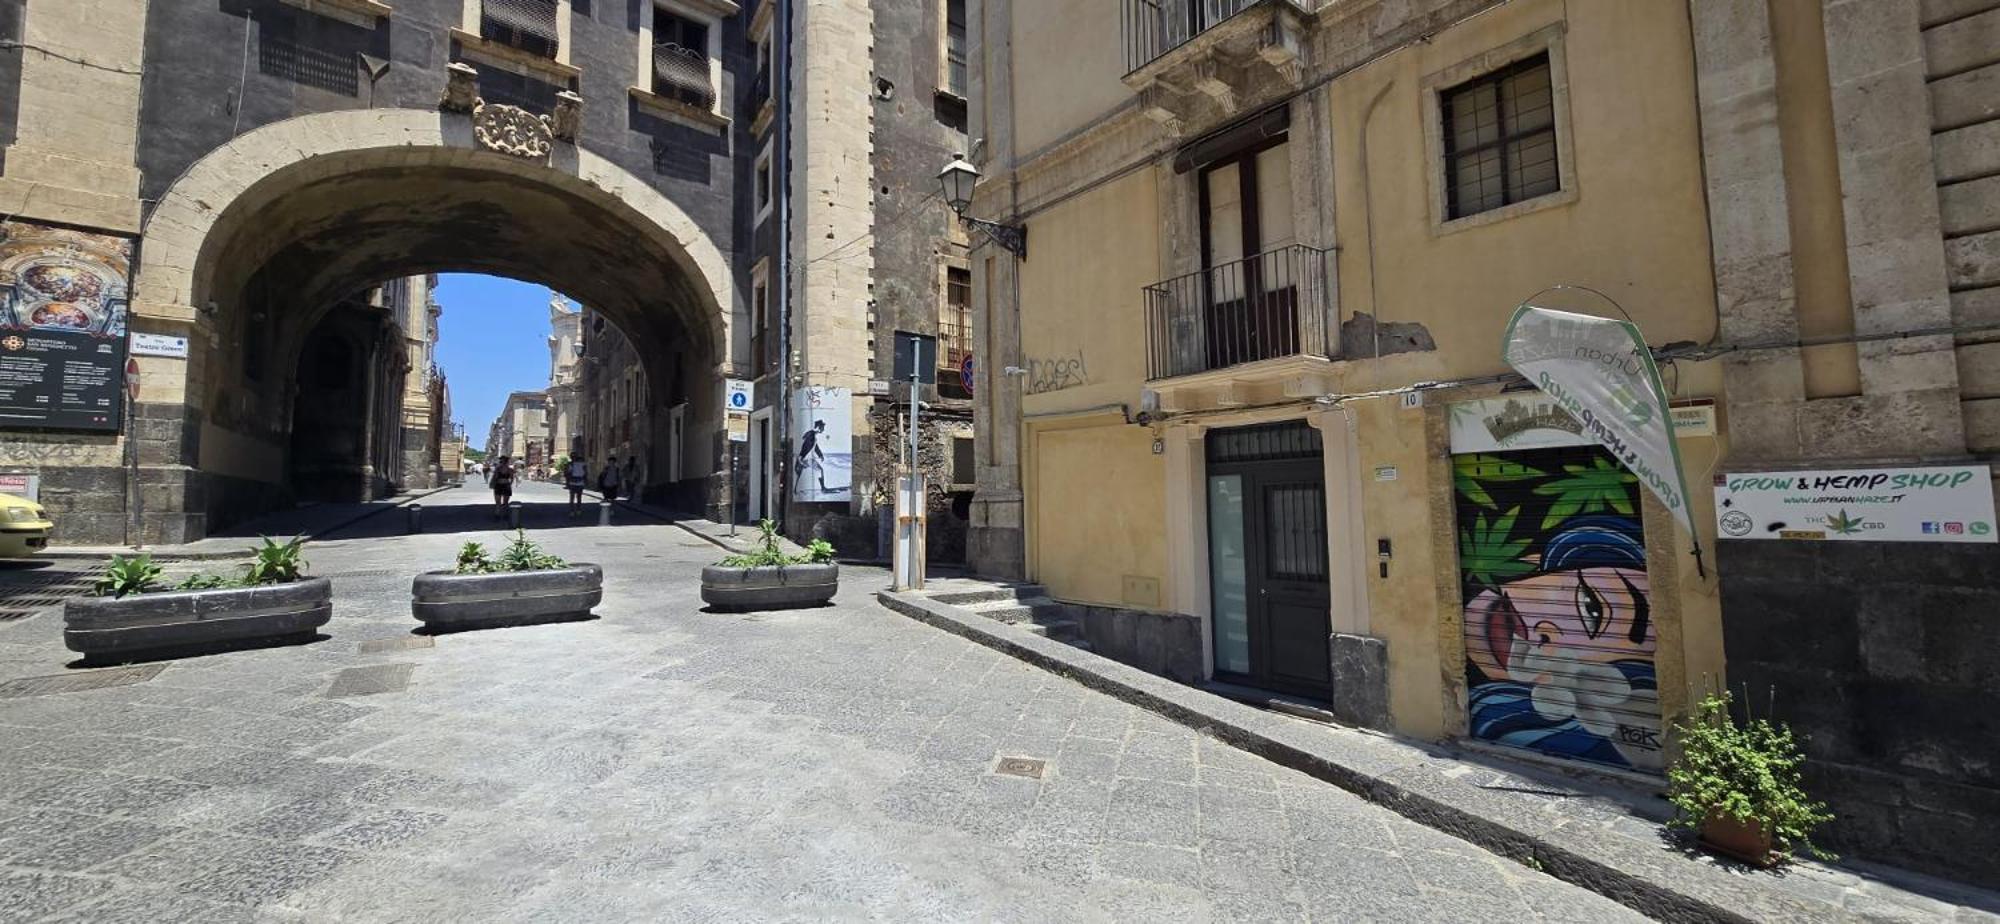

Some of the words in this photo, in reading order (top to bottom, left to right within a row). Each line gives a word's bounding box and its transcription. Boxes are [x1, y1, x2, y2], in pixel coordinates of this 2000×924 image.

[1406, 394, 1417, 406] 10
[1729, 477, 1794, 493] GROW
[1797, 478, 1809, 490] &
[1813, 473, 1889, 490] HEMP
[1890, 471, 1974, 490] SHOP
[1862, 522, 1886, 530] CBD
